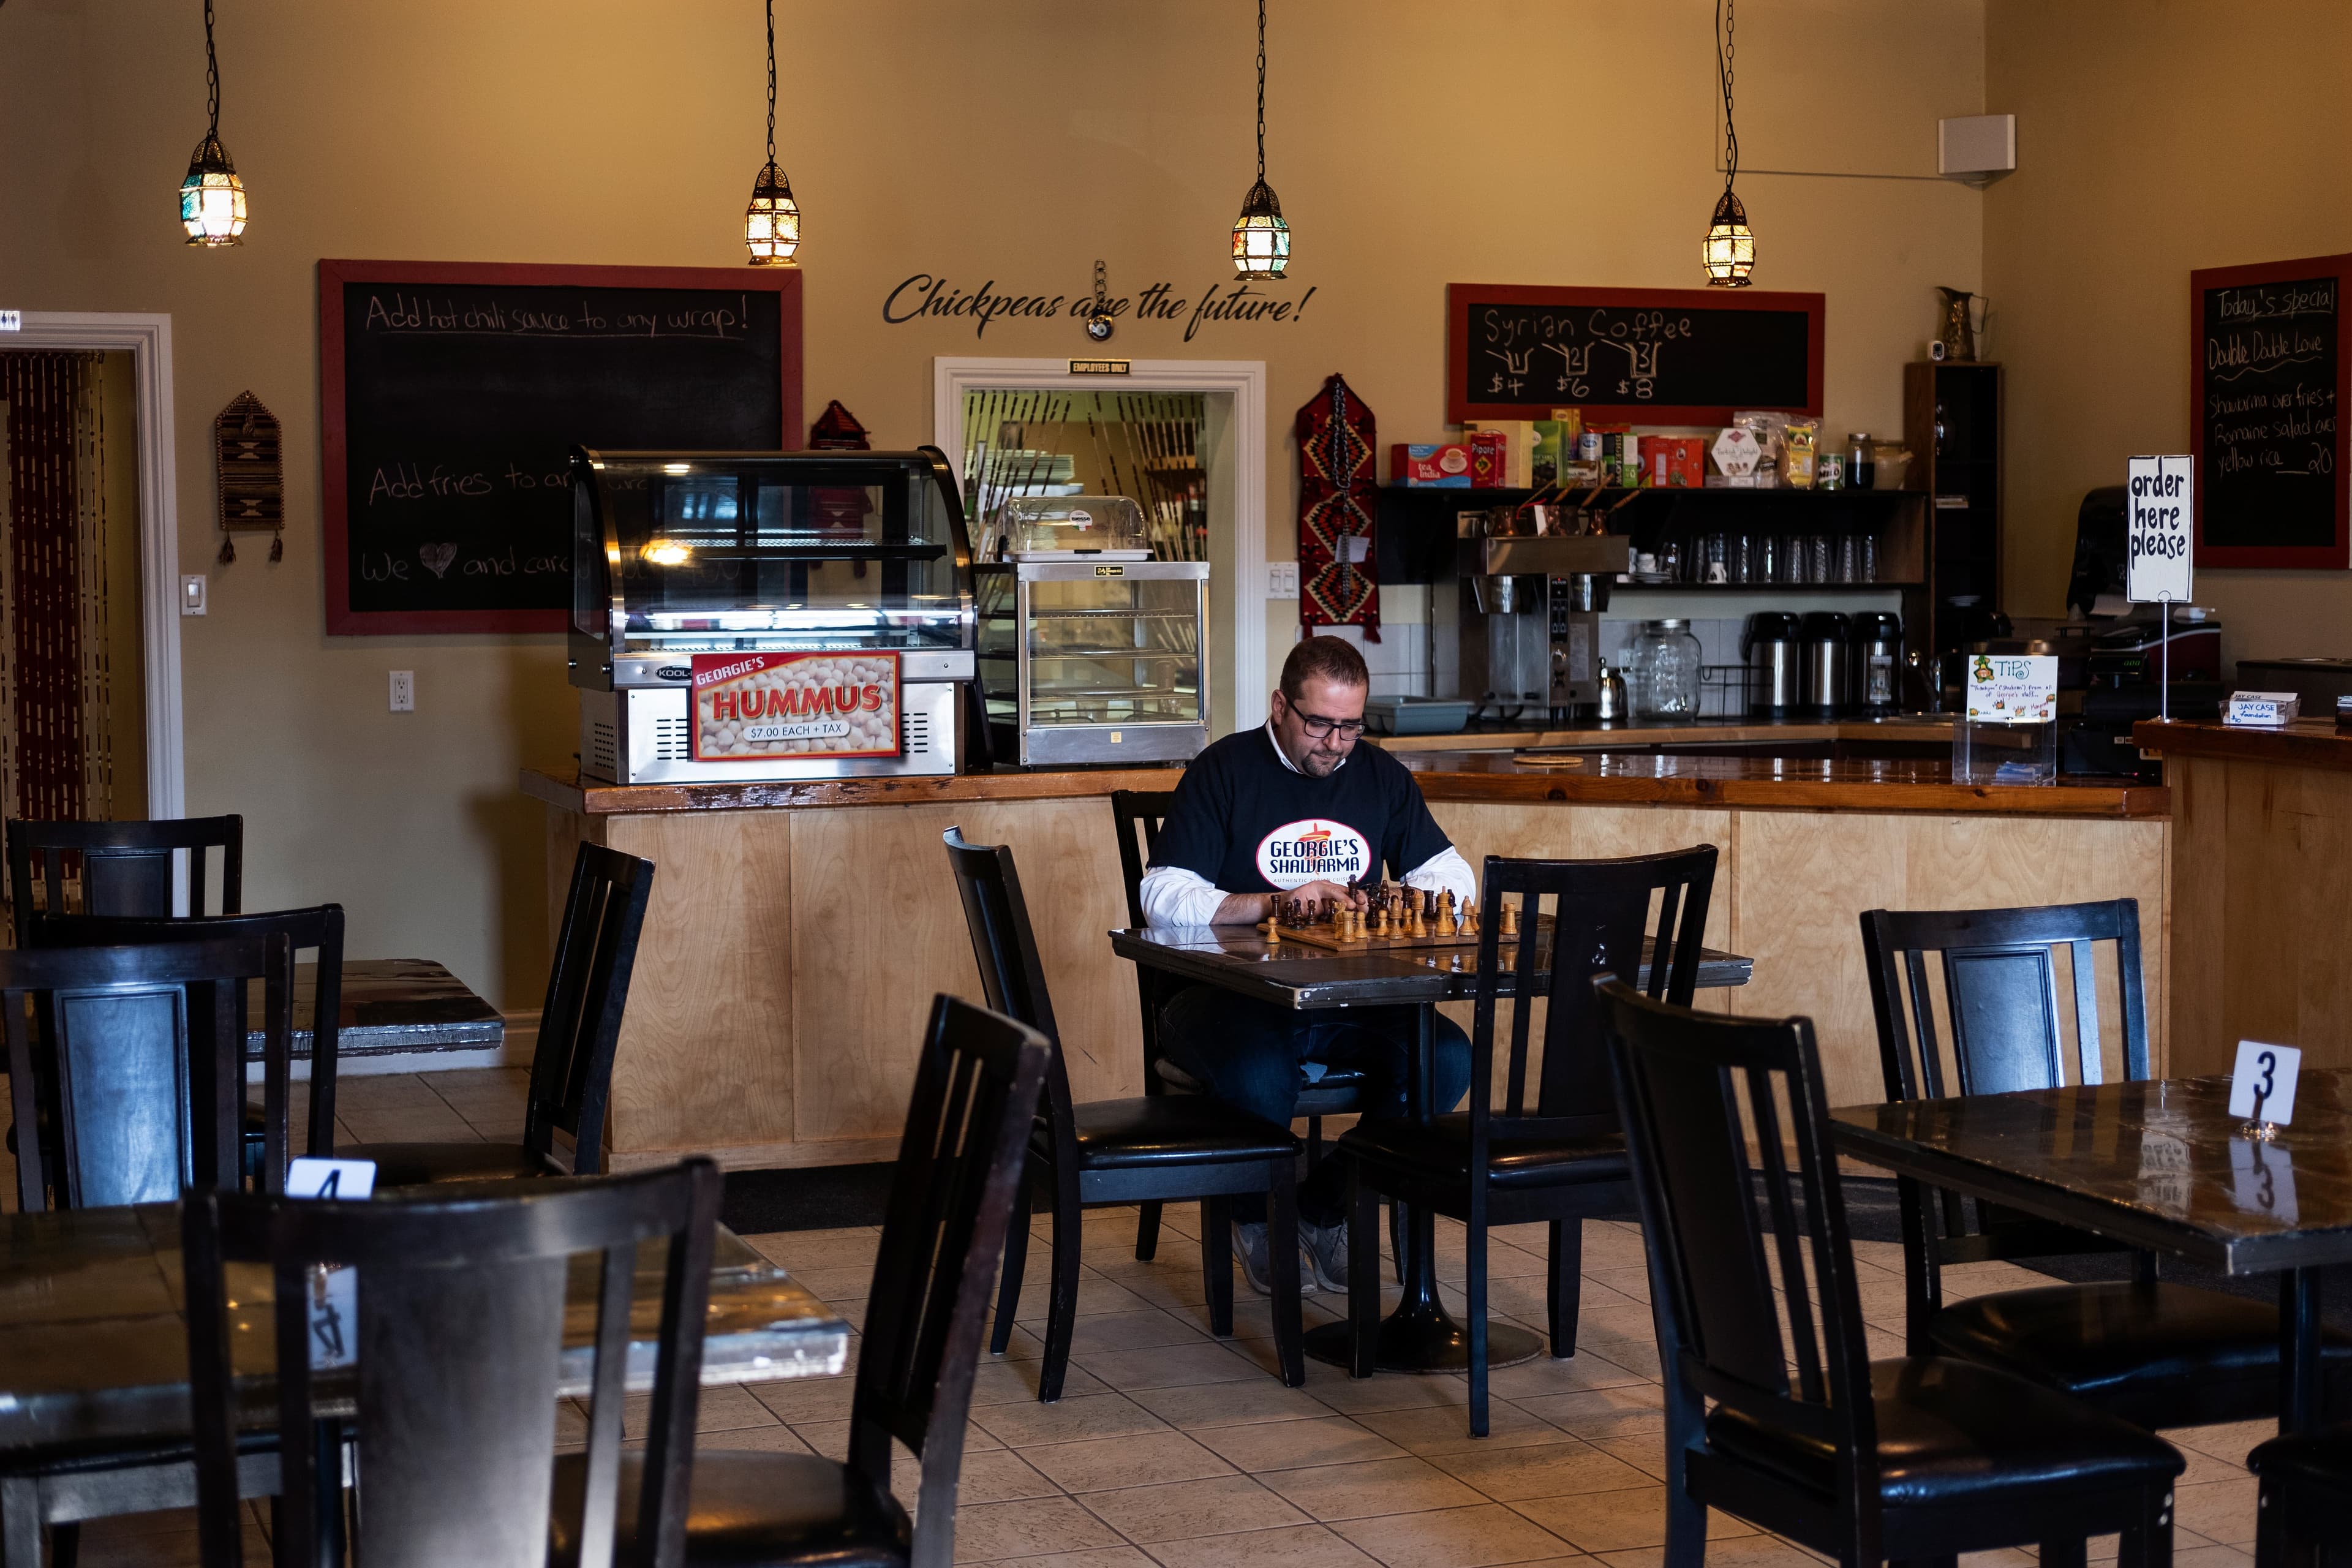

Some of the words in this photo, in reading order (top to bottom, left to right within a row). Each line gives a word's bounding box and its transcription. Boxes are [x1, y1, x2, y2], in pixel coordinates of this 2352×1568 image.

[366, 292, 421, 330] Add
[427, 298, 458, 328] hot
[465, 300, 506, 329] chili
[512, 309, 570, 331] sauce
[577, 300, 606, 328] to
[617, 314, 656, 337] any
[883, 274, 1068, 339] Chickpeas
[1135, 281, 1190, 318] the
[1183, 284, 1317, 342] future!
[2217, 289, 2275, 322] Today's
[2282, 280, 2334, 319] special
[1485, 310, 1574, 347] Syrian
[1589, 309, 1692, 341] Coffee
[1570, 347, 1582, 367] 2
[1638, 342, 1651, 369] 3
[2209, 337, 2249, 371] Double
[2253, 330, 2290, 362] Double
[2295, 328, 2323, 354] Love
[1487, 372, 1525, 398] $4
[1556, 375, 1590, 399] $6
[1616, 379, 1654, 399] $8
[2272, 394, 2293, 410] over
[2296, 382, 2323, 409] fries
[2215, 423, 2269, 447] Romaine
[2273, 409, 2310, 440] salad
[2315, 417, 2336, 434] over
[2132, 455, 2185, 497] order
[2217, 447, 2253, 483] yellow
[2260, 449, 2284, 467] rice
[2308, 442, 2333, 475] 20
[369, 461, 424, 507] Add
[429, 464, 492, 496] fries
[504, 462, 535, 491] to
[2135, 497, 2180, 530] here
[362, 549, 409, 582] We
[463, 544, 516, 576] and
[524, 555, 570, 575] care
[2131, 528, 2185, 570] please
[695, 655, 765, 686] GEORGIE'S
[712, 685, 882, 721] HUMMUS
[751, 727, 779, 739] $7.00
[782, 725, 810, 736] EACH
[823, 724, 842, 734] TAX
[1270, 839, 1359, 857] GEORGIE'S
[1270, 857, 1359, 873] SHAWARMA
[2253, 1051, 2276, 1100] 3
